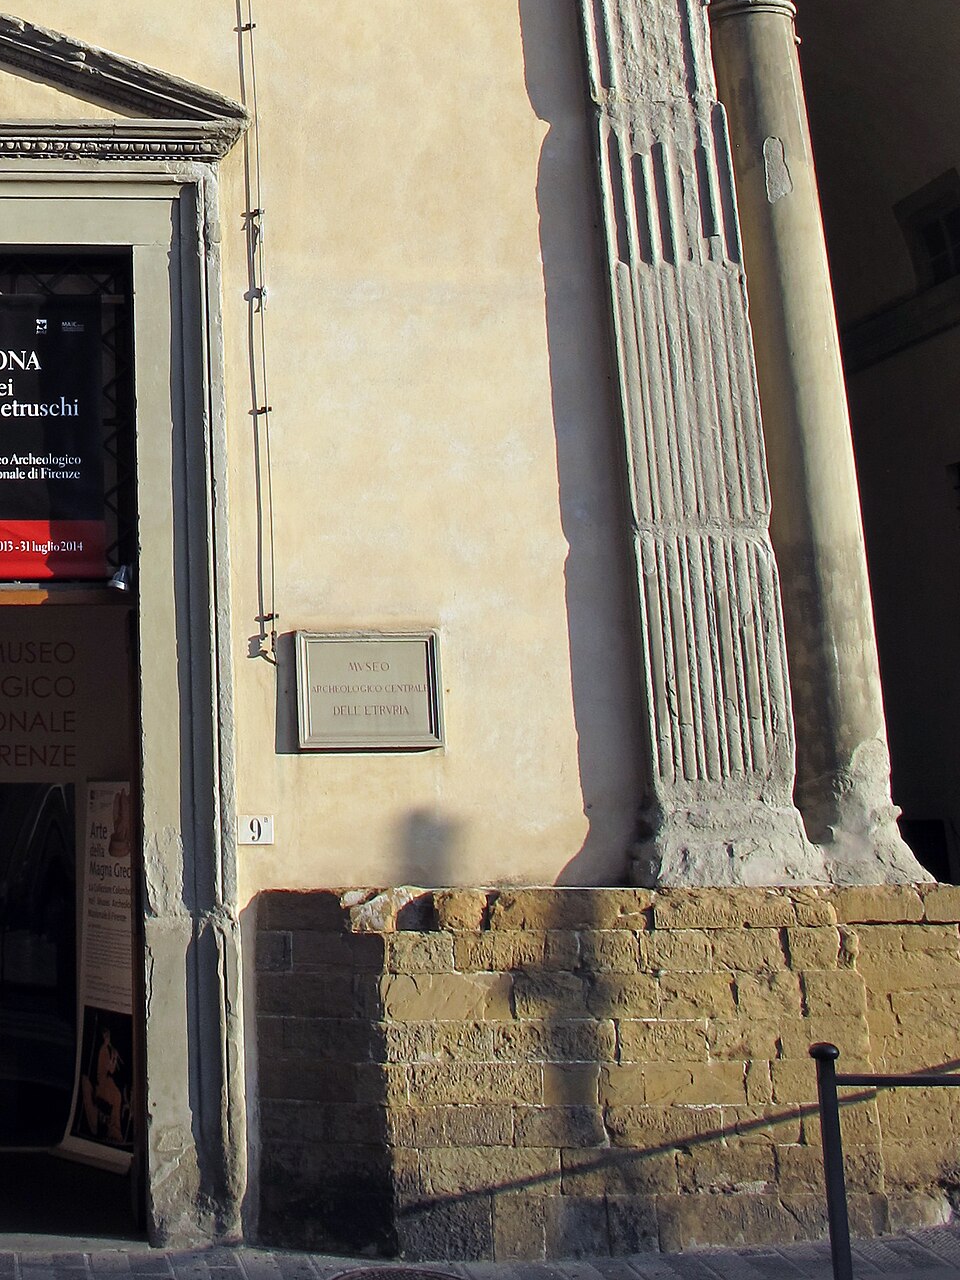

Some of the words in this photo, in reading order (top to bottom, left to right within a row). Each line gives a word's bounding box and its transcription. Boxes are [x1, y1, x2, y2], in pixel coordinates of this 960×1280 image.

[0, 396, 80, 418] etruschi
[9, 453, 82, 469] Archeologico
[27, 468, 39, 480] di
[40, 468, 81, 480] Firenze
[20, 540, 30, 552] 31
[32, 540, 60, 555] luglio
[60, 540, 84, 552] 2014
[347, 661, 390, 672] MVSEO
[311, 683, 383, 694] ARCHEOLOGICO
[90, 821, 108, 840] Arte
[249, 817, 262, 842] 9
